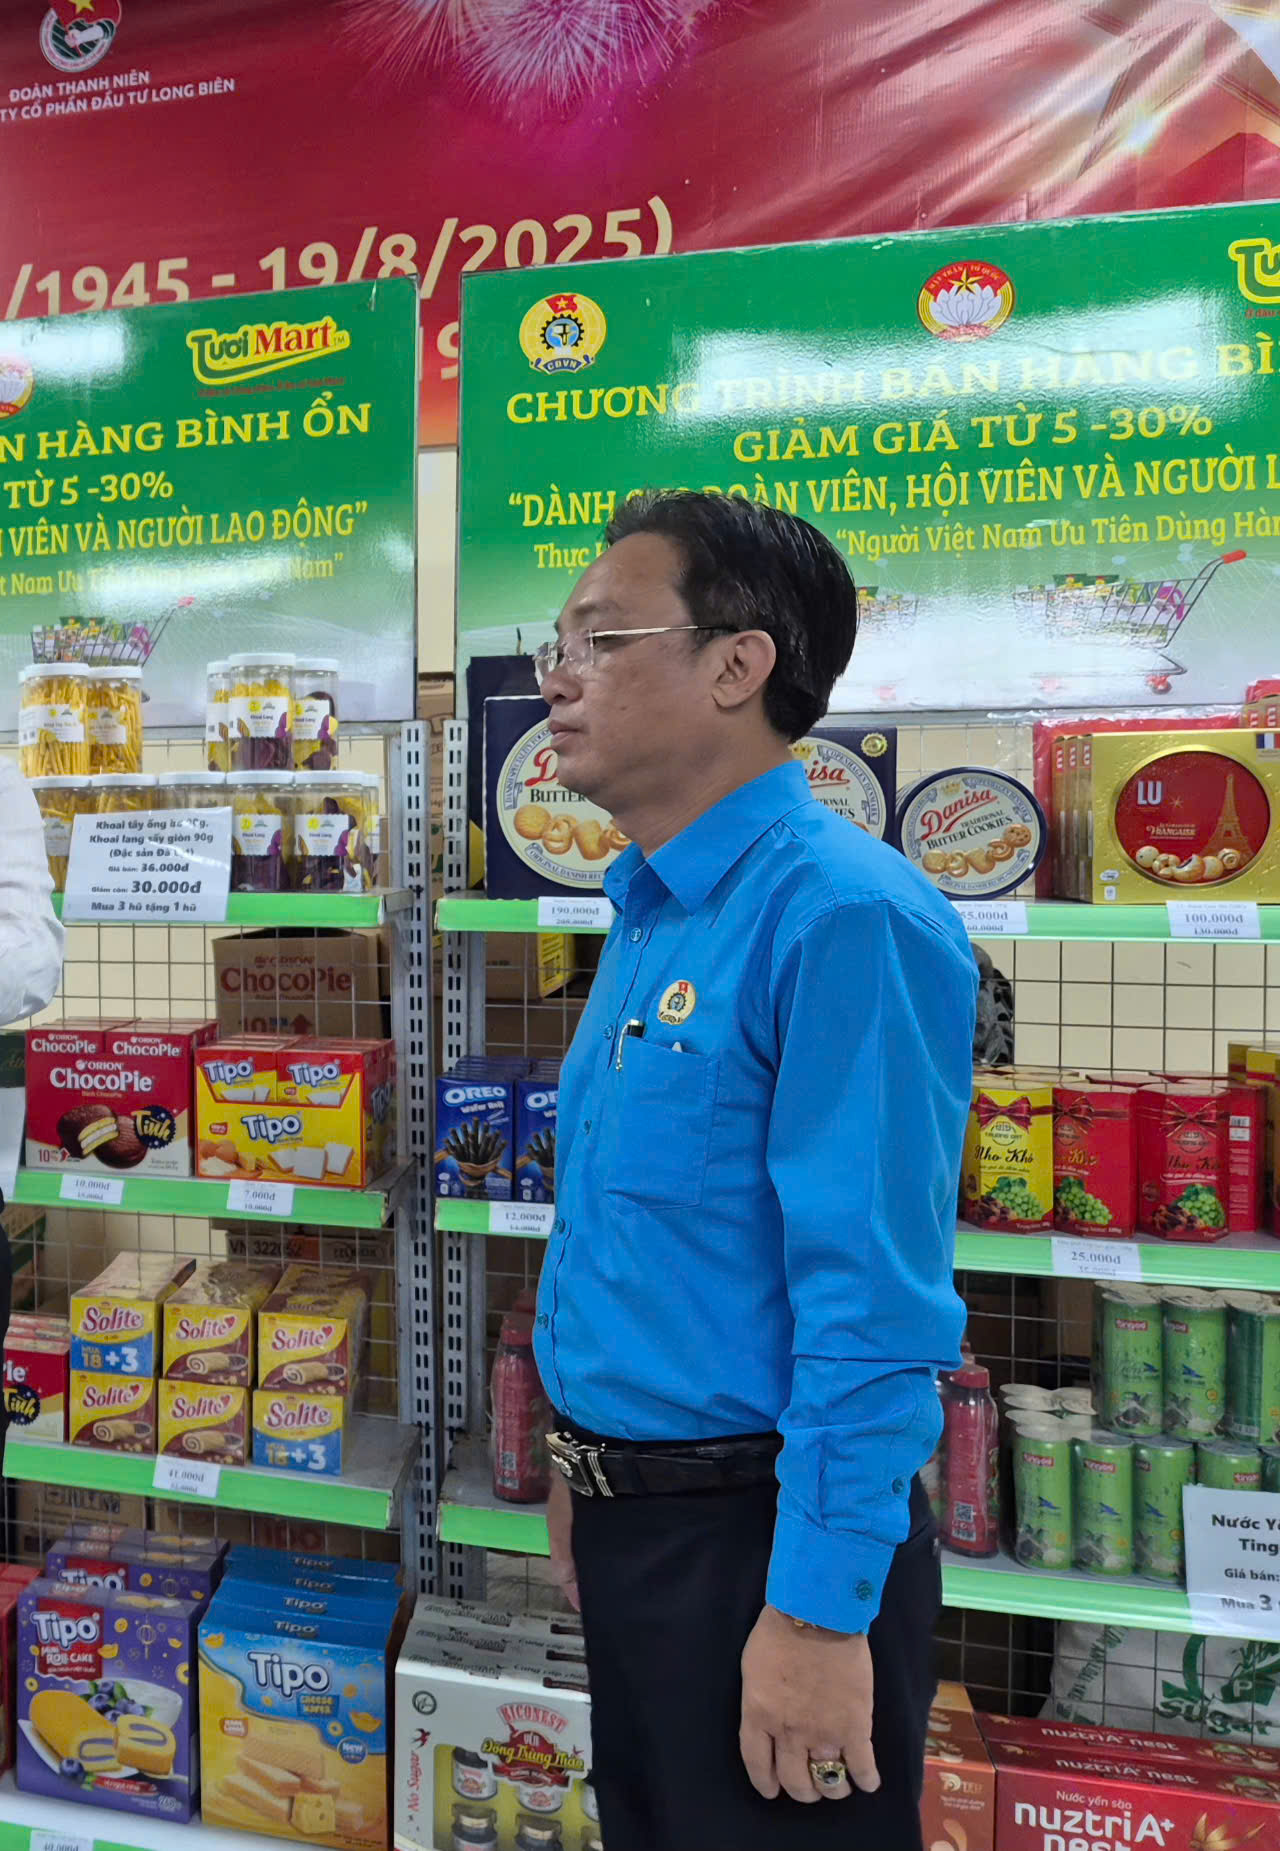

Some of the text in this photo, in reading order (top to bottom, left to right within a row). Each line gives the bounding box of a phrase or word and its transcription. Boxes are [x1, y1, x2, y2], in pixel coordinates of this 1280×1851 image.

[9, 70, 151, 102] ĐOÀN THANH NIÊN
[0, 107, 18, 122] TY
[21, 100, 41, 120] CỔ
[46, 95, 88, 115] PHẦN
[91, 92, 124, 110] ĐẦU
[127, 88, 150, 105] TƯ
[152, 83, 194, 102] LONG
[198, 76, 236, 97] BIÊN
[258, 194, 674, 302] 19/8/2025)
[506, 381, 702, 424] CHƯƠNG
[36, 420, 164, 461] HÀNG
[175, 407, 291, 449] BÌNH
[302, 390, 372, 439] ỔN
[733, 401, 1213, 463] GIẢM GIÁ TỪ 5 -30%
[4, 468, 55, 509] TỪ
[60, 475, 80, 506] 5
[86, 470, 175, 504] -30%
[807, 467, 898, 518] VIÊN,
[906, 460, 970, 518] HỘI
[977, 457, 1065, 505] VIÊN
[1071, 451, 1126, 500] VÀ
[1135, 442, 1258, 497] NGƯỜI
[10, 516, 70, 557] VIÊN
[73, 511, 111, 554] VÀ
[117, 504, 205, 551] NGƯỜI
[210, 509, 266, 544] LAO
[271, 496, 369, 550] ĐỘNG”
[533, 542, 590, 576] Thực
[925, 521, 977, 561] Việt
[981, 522, 1042, 550] Nam
[1049, 516, 1087, 547] Ưu
[1091, 513, 1150, 546] Tiên
[1155, 509, 1227, 548] Dùng
[11, 573, 54, 595] Nam
[1136, 780, 1163, 806] LU
[96, 820, 125, 830] Khoai
[128, 819, 145, 832] tây
[920, 788, 993, 841] Danisa
[89, 831, 215, 846] Khoai lang giòn 90g
[925, 830, 967, 850] BUTTER
[135, 847, 154, 858] sản
[140, 862, 190, 874] 36.000đ
[130, 880, 203, 895] 30.000đ
[90, 900, 171, 915] Mua 3 tặng
[220, 965, 353, 993] ChocoPie
[30, 1038, 97, 1054] ChocoPie
[112, 1041, 181, 1057] ChocoPie
[87, 1061, 123, 1071] ORION
[204, 1060, 253, 1086] Tipo
[287, 1061, 341, 1089] Tipo
[49, 1067, 153, 1092] ChocoPie
[443, 1086, 508, 1107] OREO
[240, 1114, 303, 1145] Tipo
[81, 1306, 144, 1333] Solite
[175, 1318, 227, 1341] Solite
[271, 1328, 325, 1351] Solite
[82, 1351, 103, 1369] 18
[82, 1386, 134, 1409] Solite
[171, 1397, 223, 1420] Solite
[265, 1400, 332, 1429] Solite
[1211, 1513, 1261, 1531] Nước
[1224, 1567, 1280, 1582] Giá bán:
[283, 1596, 327, 1612] Tipo
[1221, 1593, 1274, 1612] Mua 3
[31, 1610, 100, 1650] Tipo
[273, 1620, 320, 1636] Tipo
[69, 1652, 94, 1664] CAKE
[247, 1651, 331, 1699] Tipo
[1127, 1736, 1183, 1752] nest
[1147, 1769, 1200, 1786] nest
[1055, 1789, 1086, 1806] Nước
[1086, 1794, 1110, 1811] yến
